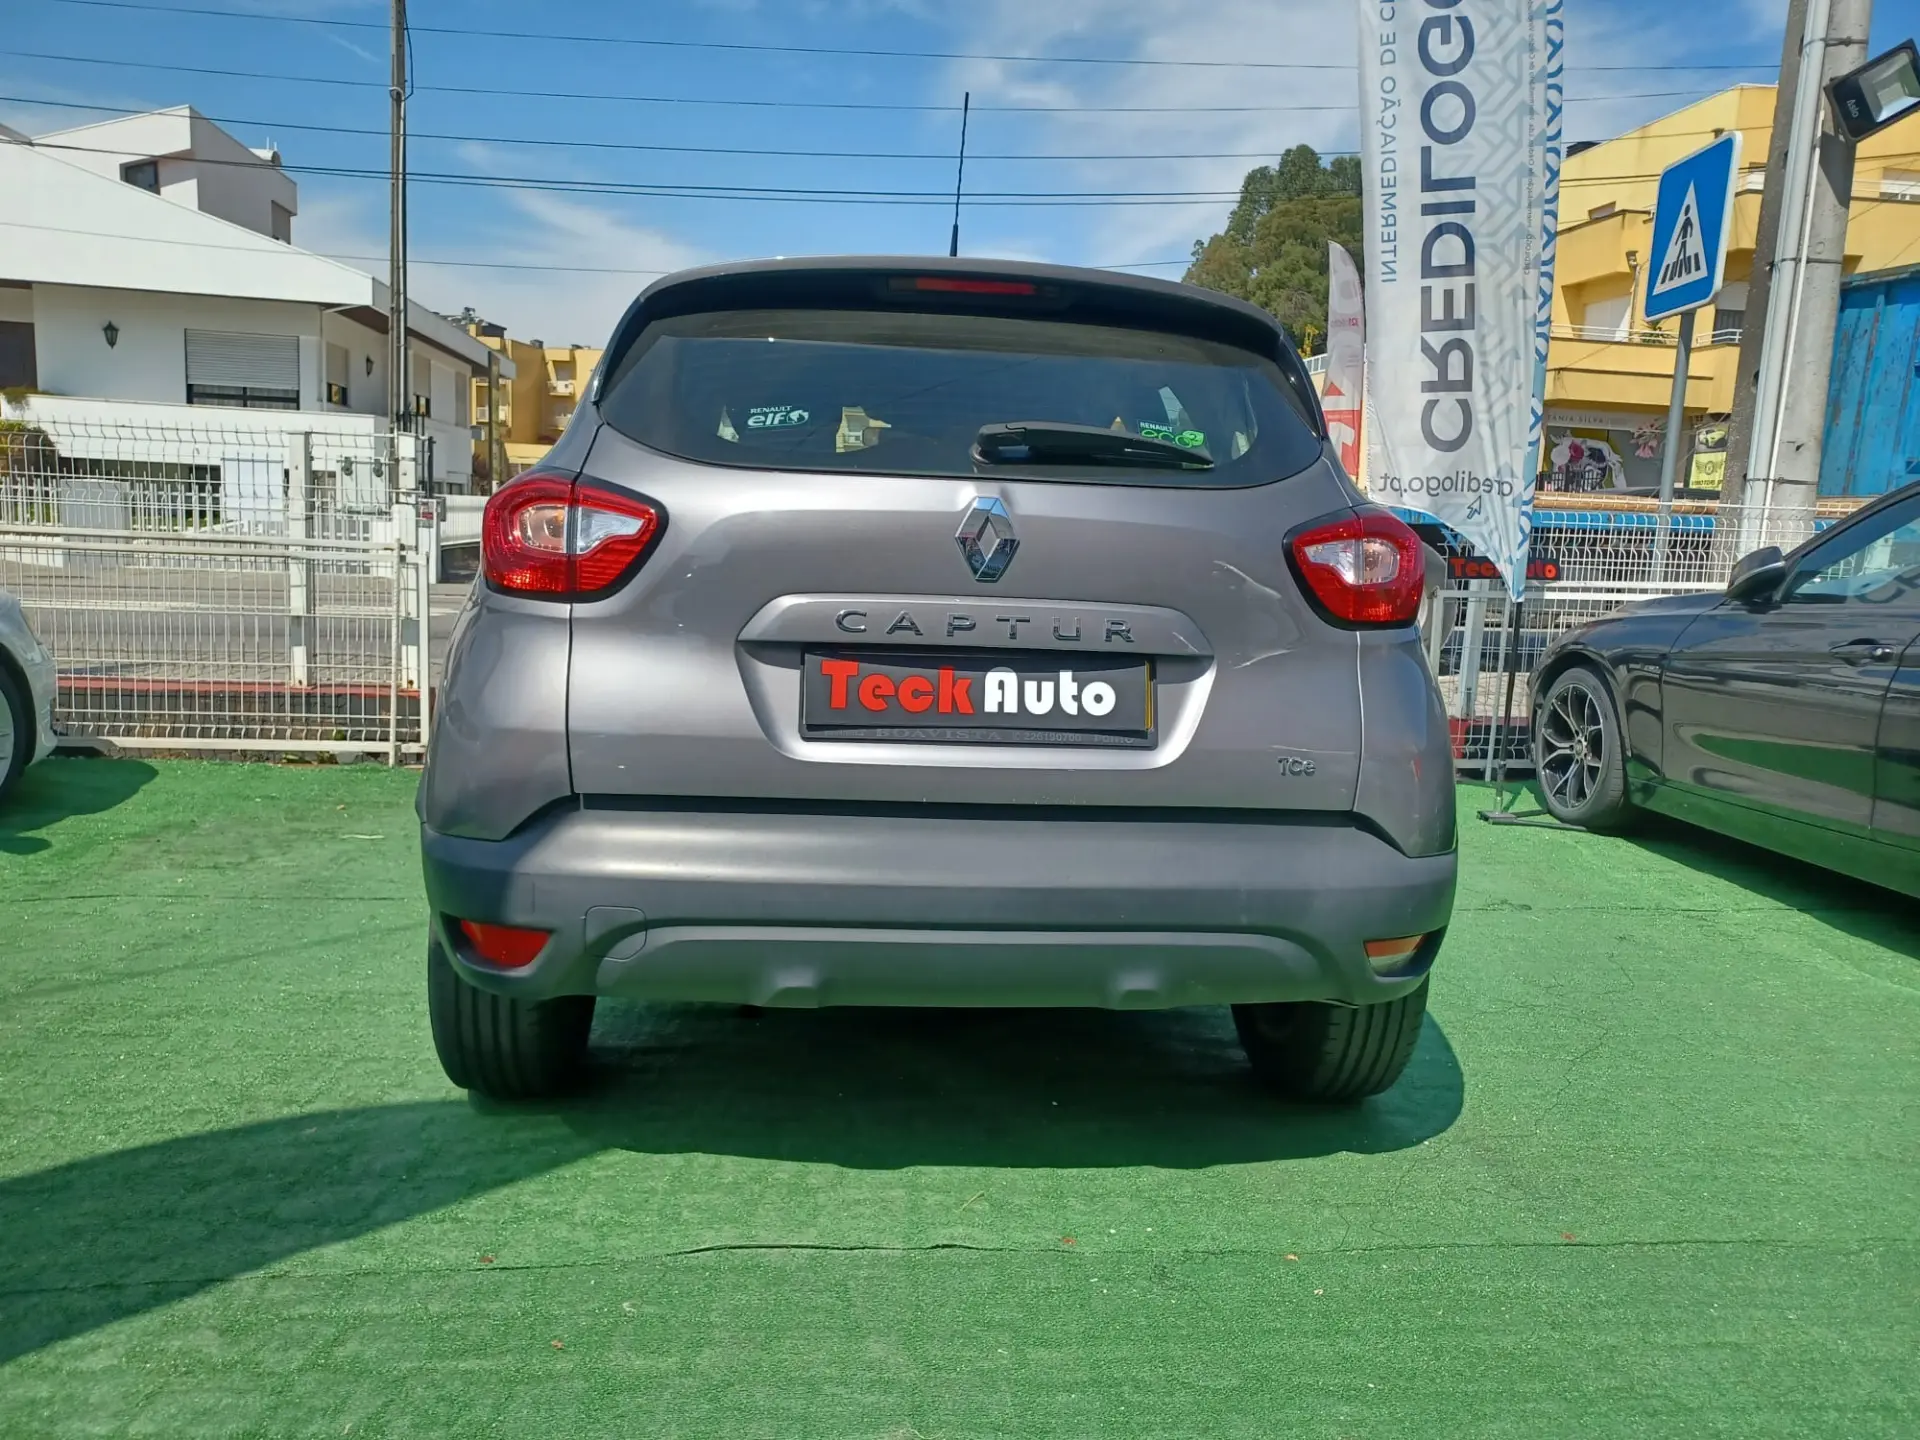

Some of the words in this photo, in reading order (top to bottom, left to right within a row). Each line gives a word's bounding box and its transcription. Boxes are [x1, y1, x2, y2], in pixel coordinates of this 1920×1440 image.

[749, 405, 792, 414] RENAULT
[747, 412, 786, 427] elf
[1140, 421, 1173, 433] RENAULT
[835, 609, 1135, 643] CAPTUR
[821, 659, 976, 715] Teck
[983, 666, 1117, 716] Auto
[1276, 755, 1316, 776] TCe
